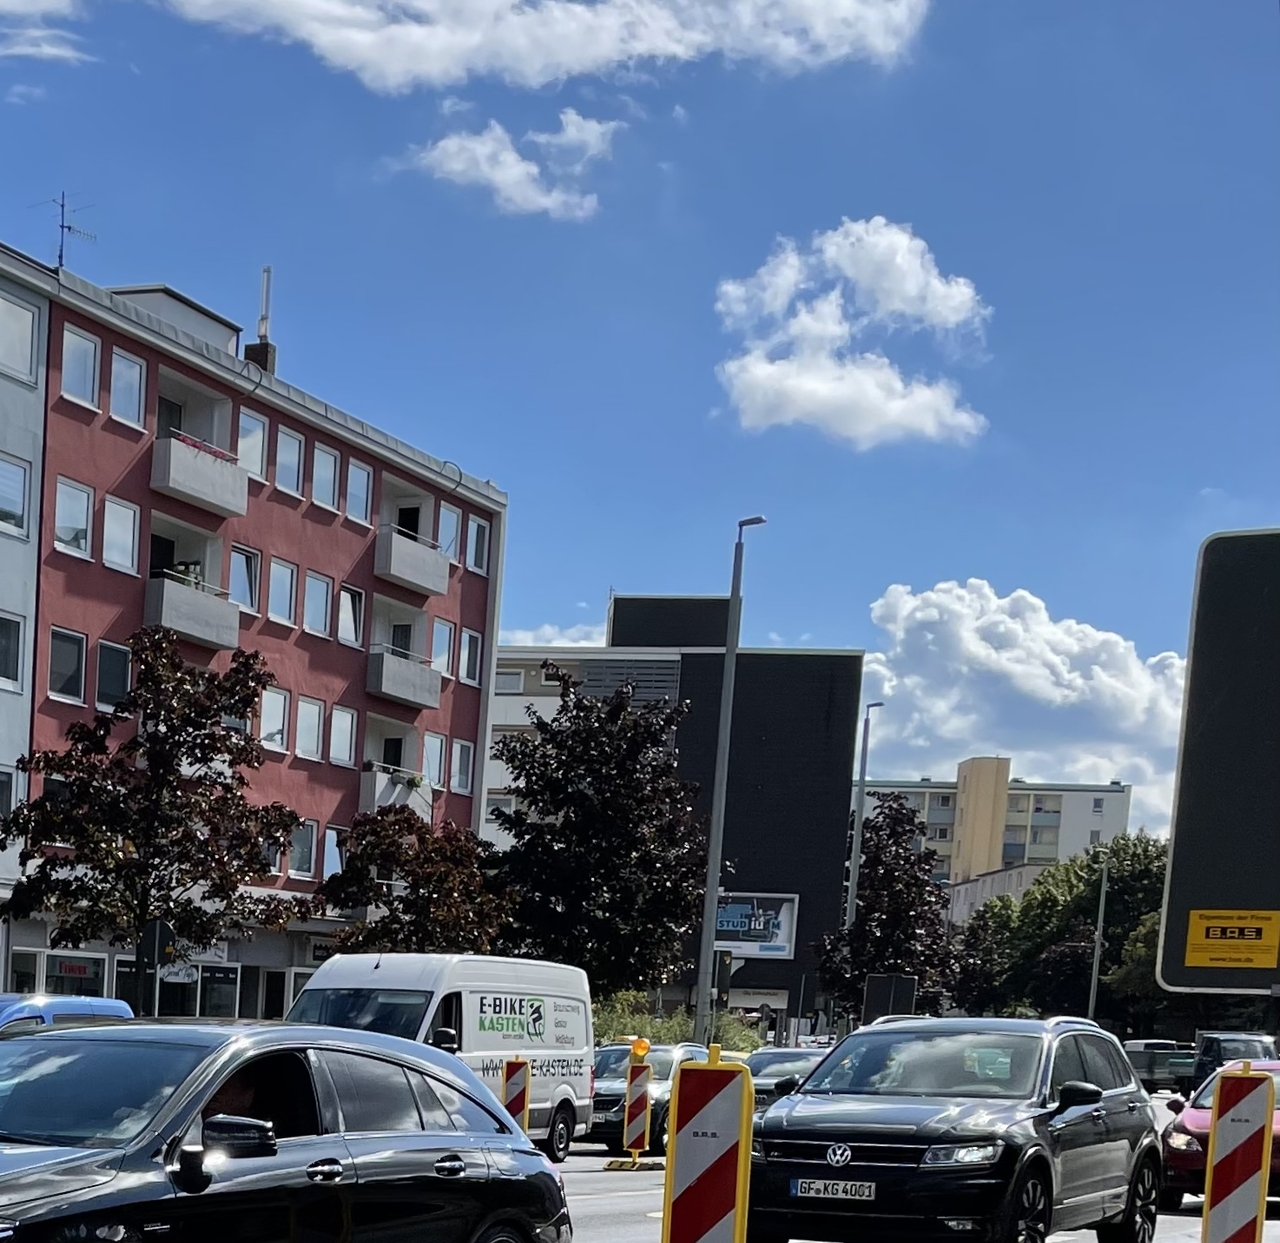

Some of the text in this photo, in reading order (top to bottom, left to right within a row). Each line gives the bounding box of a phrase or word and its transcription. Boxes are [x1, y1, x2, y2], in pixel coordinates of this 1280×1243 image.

[479, 996, 526, 1015] E-BIKE
[478, 1016, 525, 1033] KASTEN
[799, 1180, 873, 1198] GF KG 4001
